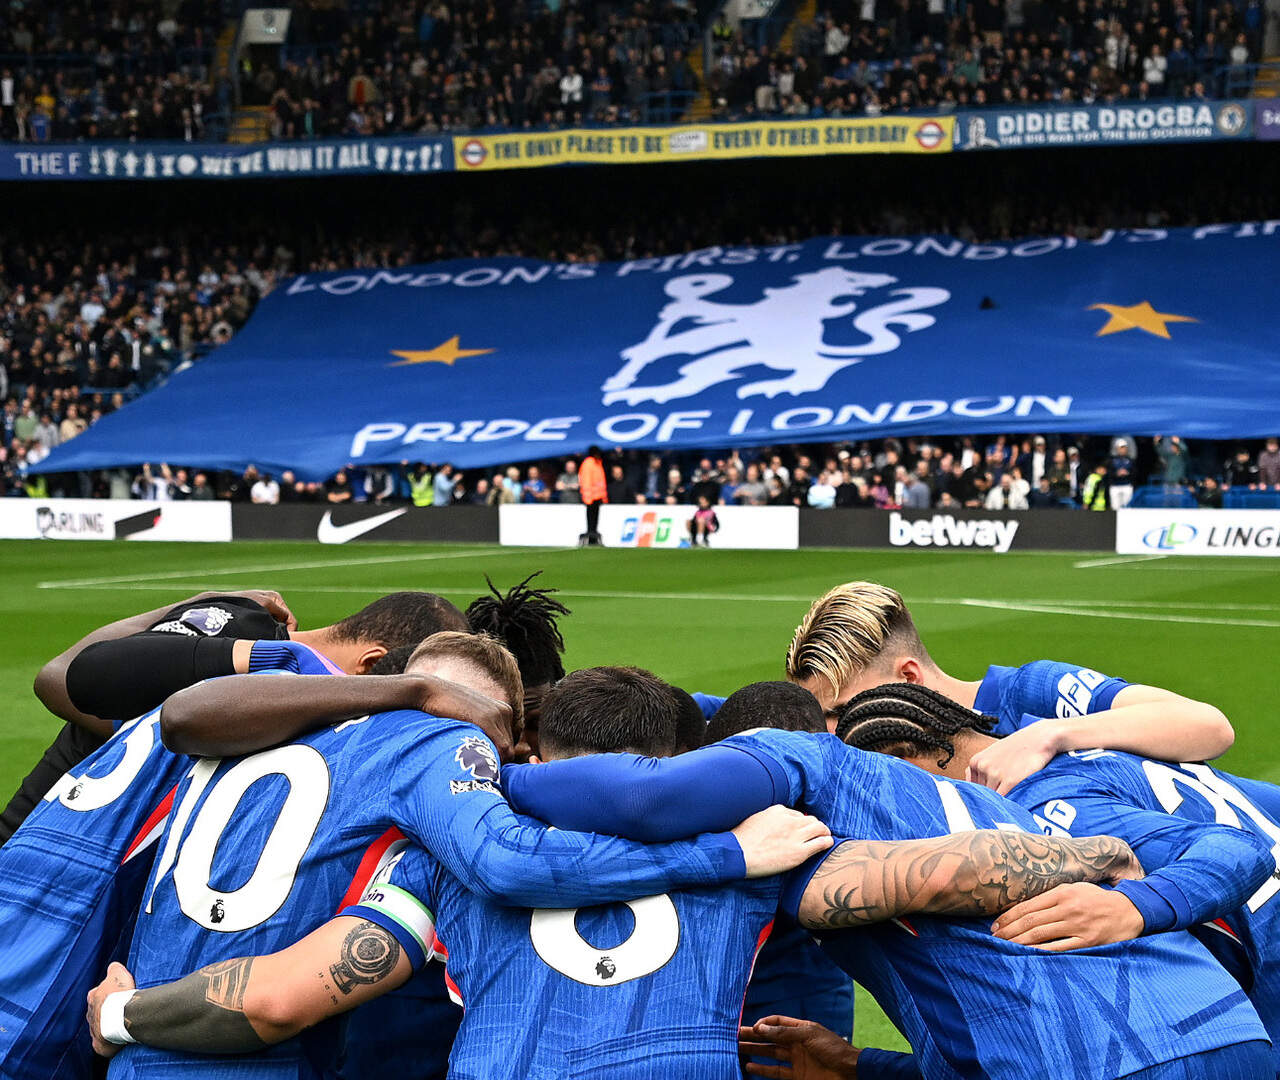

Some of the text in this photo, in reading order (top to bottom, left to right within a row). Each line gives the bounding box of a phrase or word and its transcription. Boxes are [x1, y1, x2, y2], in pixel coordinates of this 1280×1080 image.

[997, 105, 1213, 135] DIDIER DROGBA
[568, 135, 614, 154] PLACE
[619, 136, 639, 154] TO
[712, 129, 762, 149] EVERY
[767, 127, 819, 146] OTHER
[823, 126, 909, 145] SATURDAY
[14, 152, 63, 175] THE
[286, 263, 597, 296] LONDON'S
[350, 395, 1073, 457] PRIDE OF LONDON
[889, 512, 1019, 552] betway
[146, 743, 330, 933] 10
